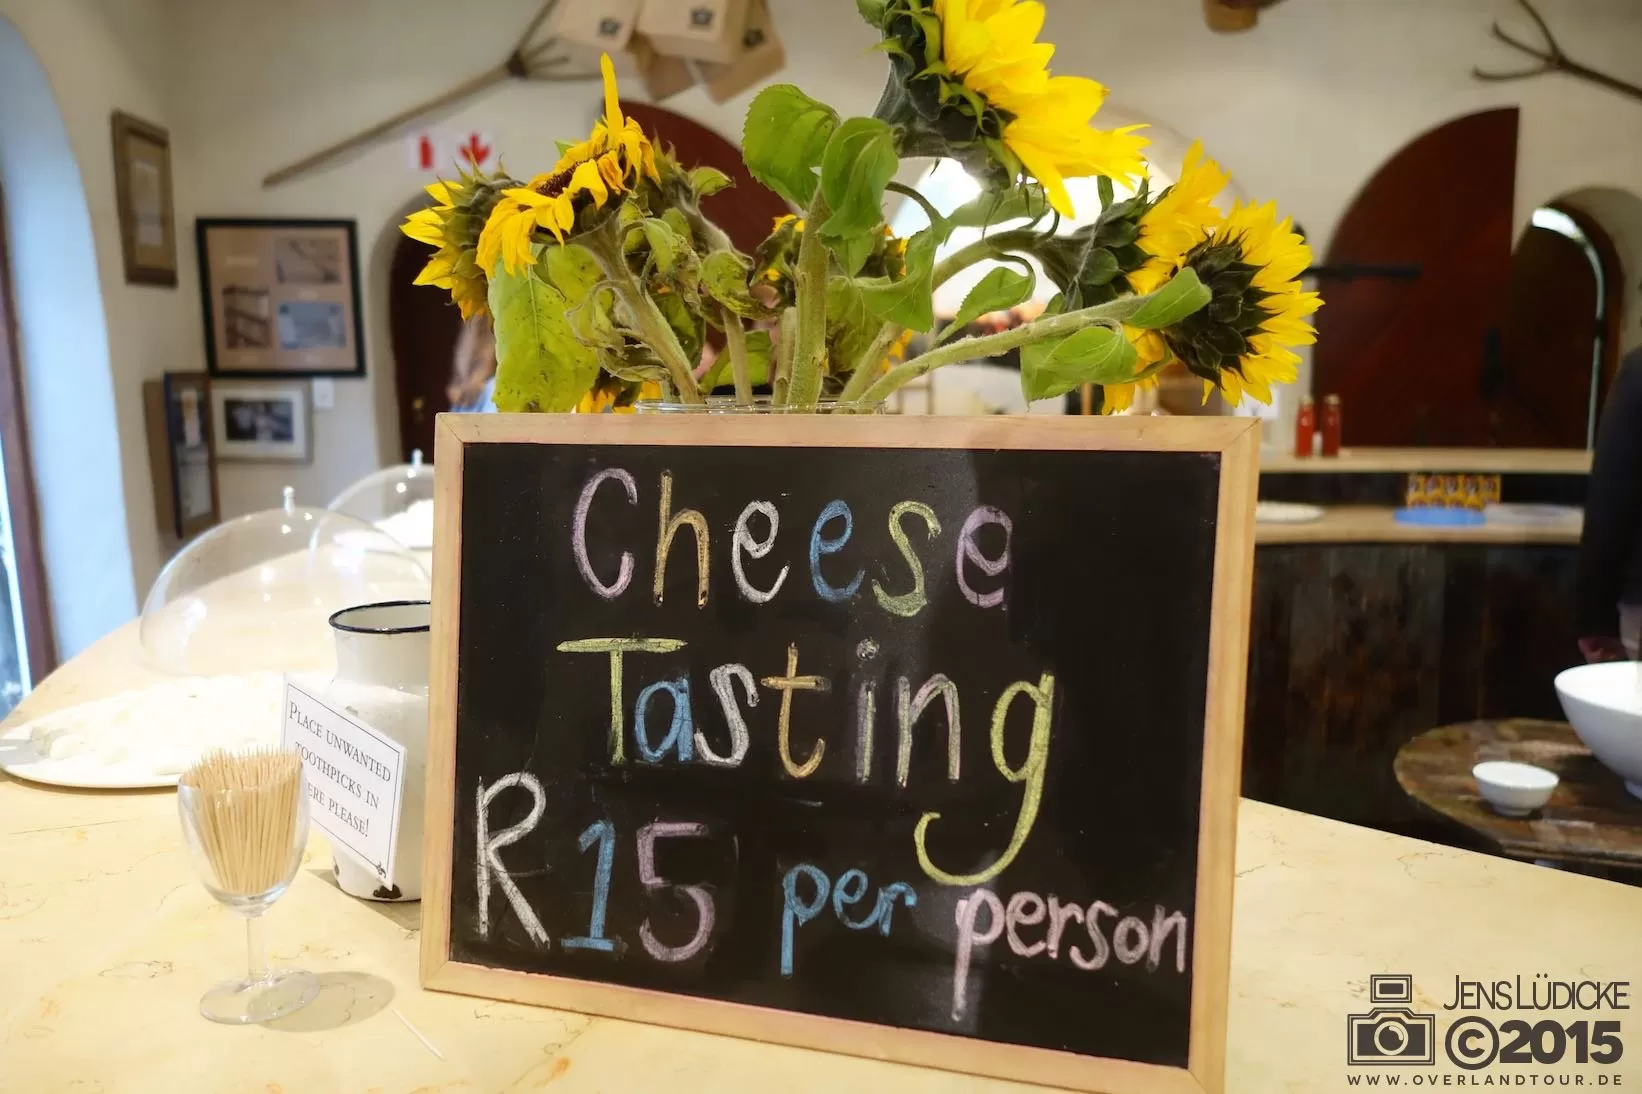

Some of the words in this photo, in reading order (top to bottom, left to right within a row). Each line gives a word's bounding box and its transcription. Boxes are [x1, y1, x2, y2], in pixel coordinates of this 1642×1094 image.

[572, 467, 1013, 617] Cheese
[289, 702, 322, 737] PLACE
[327, 731, 390, 781] UNWANTED
[556, 638, 1056, 886] Tasting
[307, 782, 324, 805] ERE
[328, 797, 369, 838] PLEASE!
[367, 791, 379, 809] IN
[780, 863, 917, 977] per
[953, 887, 1187, 1021] person
